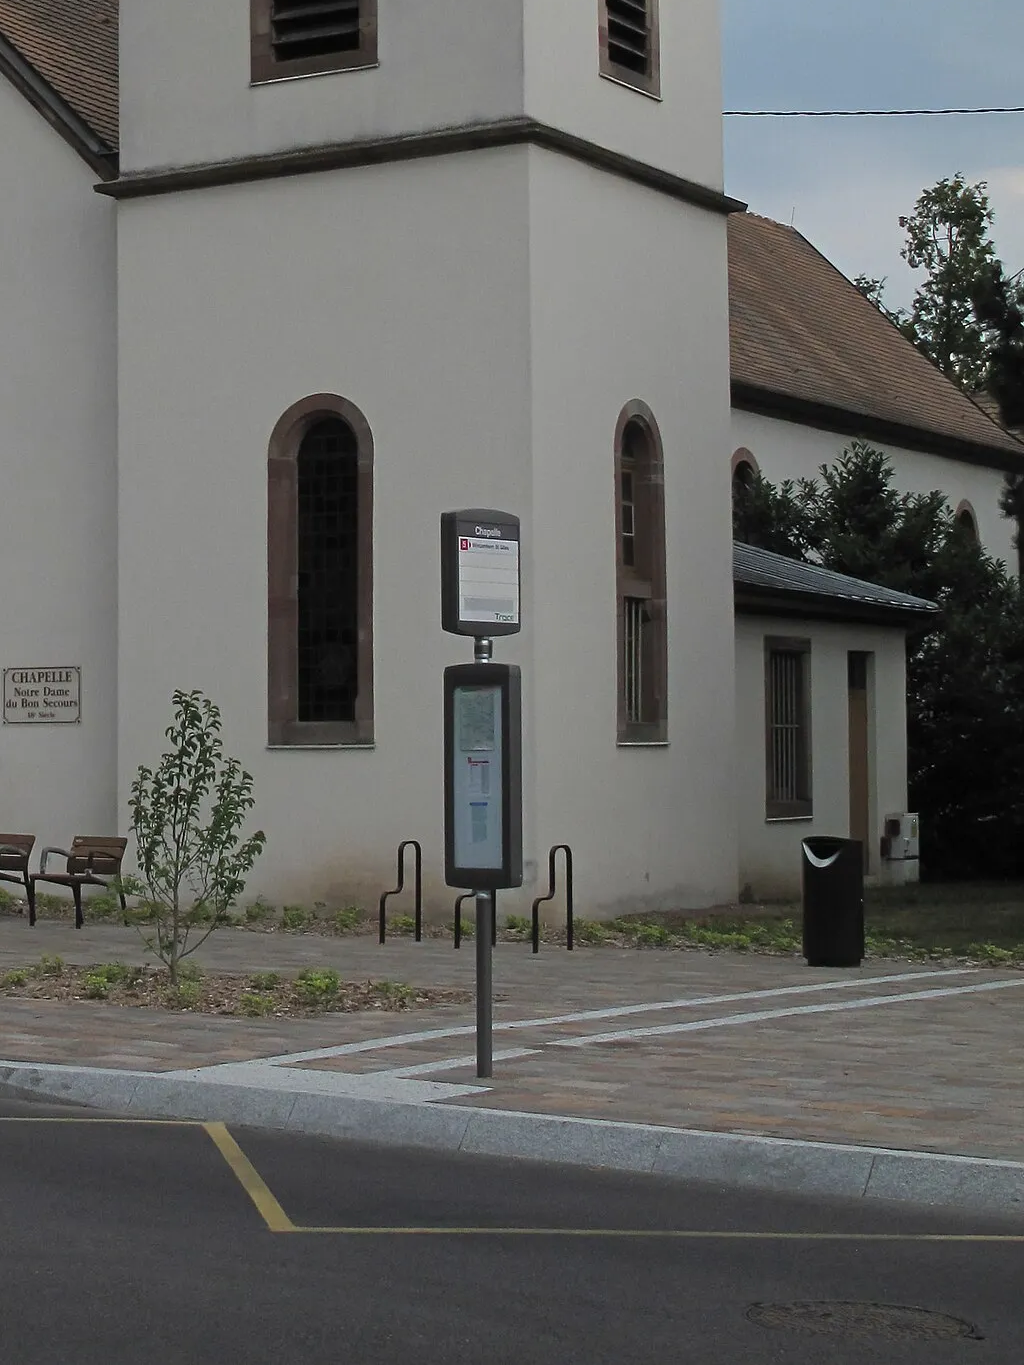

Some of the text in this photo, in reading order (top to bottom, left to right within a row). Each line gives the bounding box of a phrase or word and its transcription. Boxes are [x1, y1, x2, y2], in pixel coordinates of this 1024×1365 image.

[12, 671, 72, 683] CHAPELLE
[14, 686, 70, 696] Notre Dame
[6, 698, 78, 708] du Bon Secours
